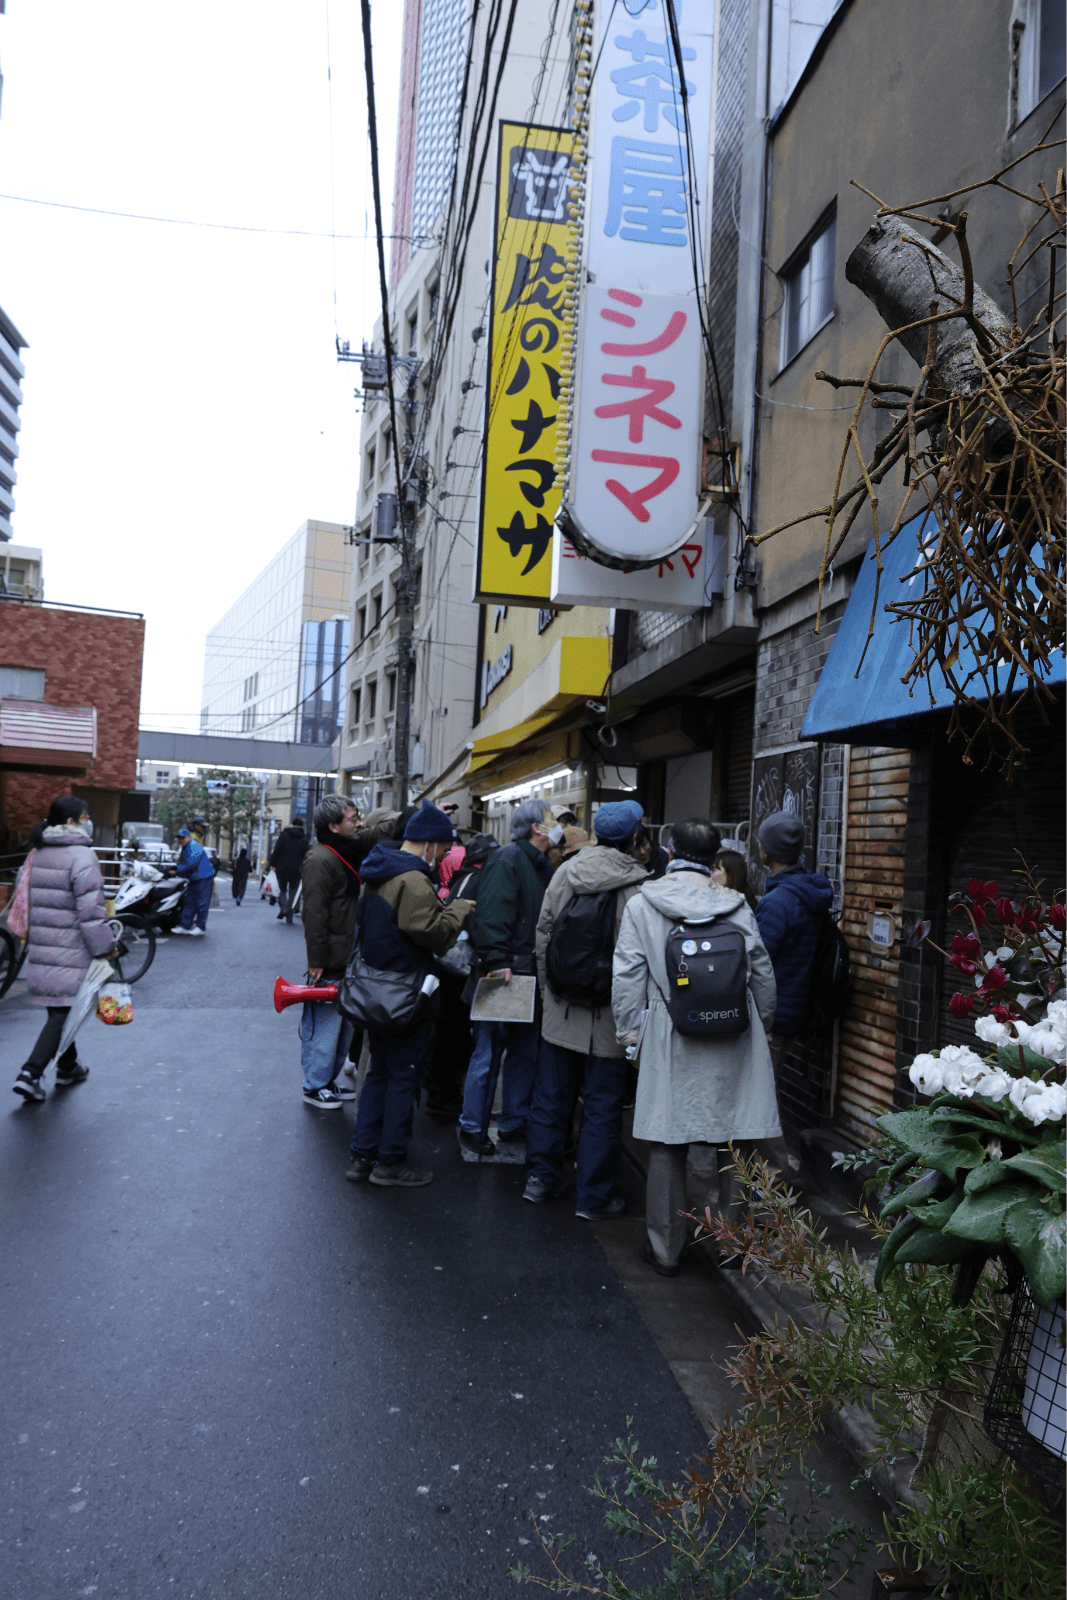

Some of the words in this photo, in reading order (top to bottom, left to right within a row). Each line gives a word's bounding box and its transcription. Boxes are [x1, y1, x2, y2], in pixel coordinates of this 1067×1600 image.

[604, 0, 697, 247] 茶屋
[591, 288, 688, 522] シネマ
[700, 1008, 740, 1023] spirent
